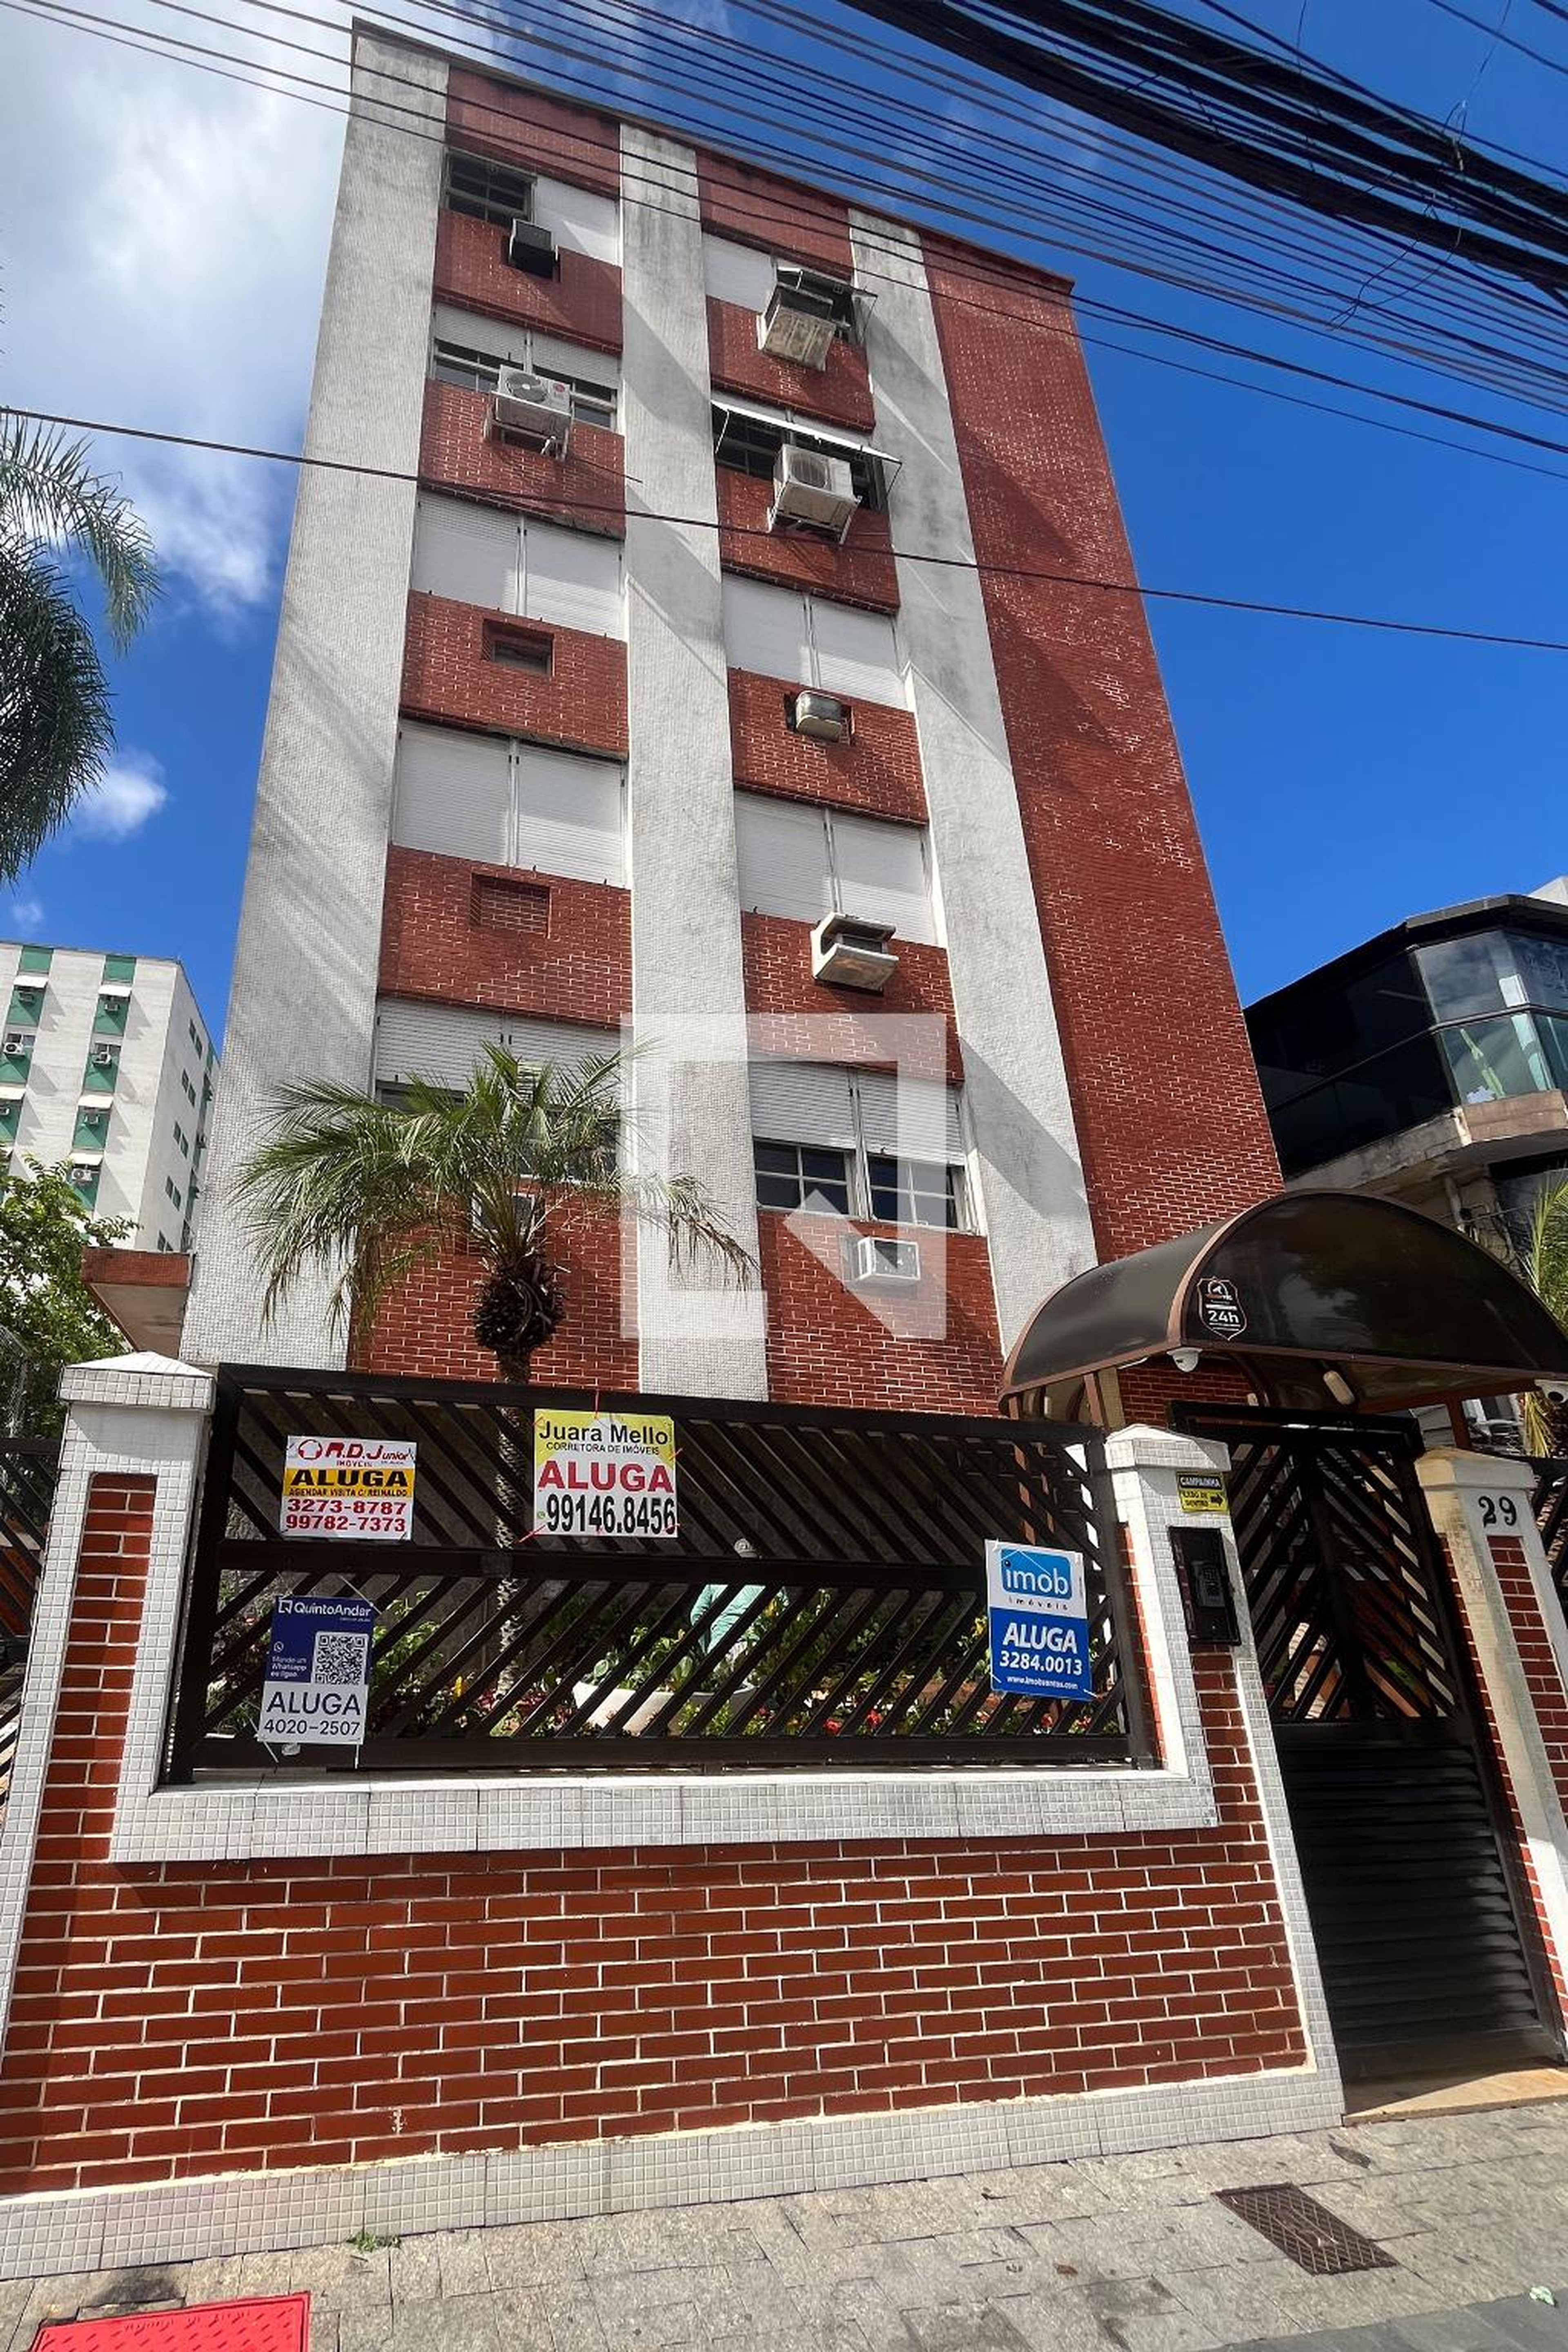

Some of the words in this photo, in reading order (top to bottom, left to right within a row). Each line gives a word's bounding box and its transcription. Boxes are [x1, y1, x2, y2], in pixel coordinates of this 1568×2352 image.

[1208, 1310, 1239, 1323] 24h
[539, 1421, 602, 1442] Juara
[610, 1424, 668, 1445] Mello
[546, 1442, 606, 1452] CORRETORA
[608, 1445, 621, 1453] DE
[290, 1470, 408, 1487] ALUGA
[538, 1460, 674, 1493] ALUGA
[287, 1499, 407, 1515] 3273-8787
[546, 1493, 675, 1535] 99146.8456
[1478, 1496, 1517, 1528] 29
[286, 1514, 406, 1532] 99782-7373
[1005, 1567, 1069, 1595] imob
[294, 1602, 371, 1616] QuintoAndar
[1002, 1622, 1078, 1654] ALUGA
[999, 1650, 1082, 1676] 3284.0013
[266, 1692, 361, 1715] ALUGA
[264, 1719, 360, 1735] 4020-2507
